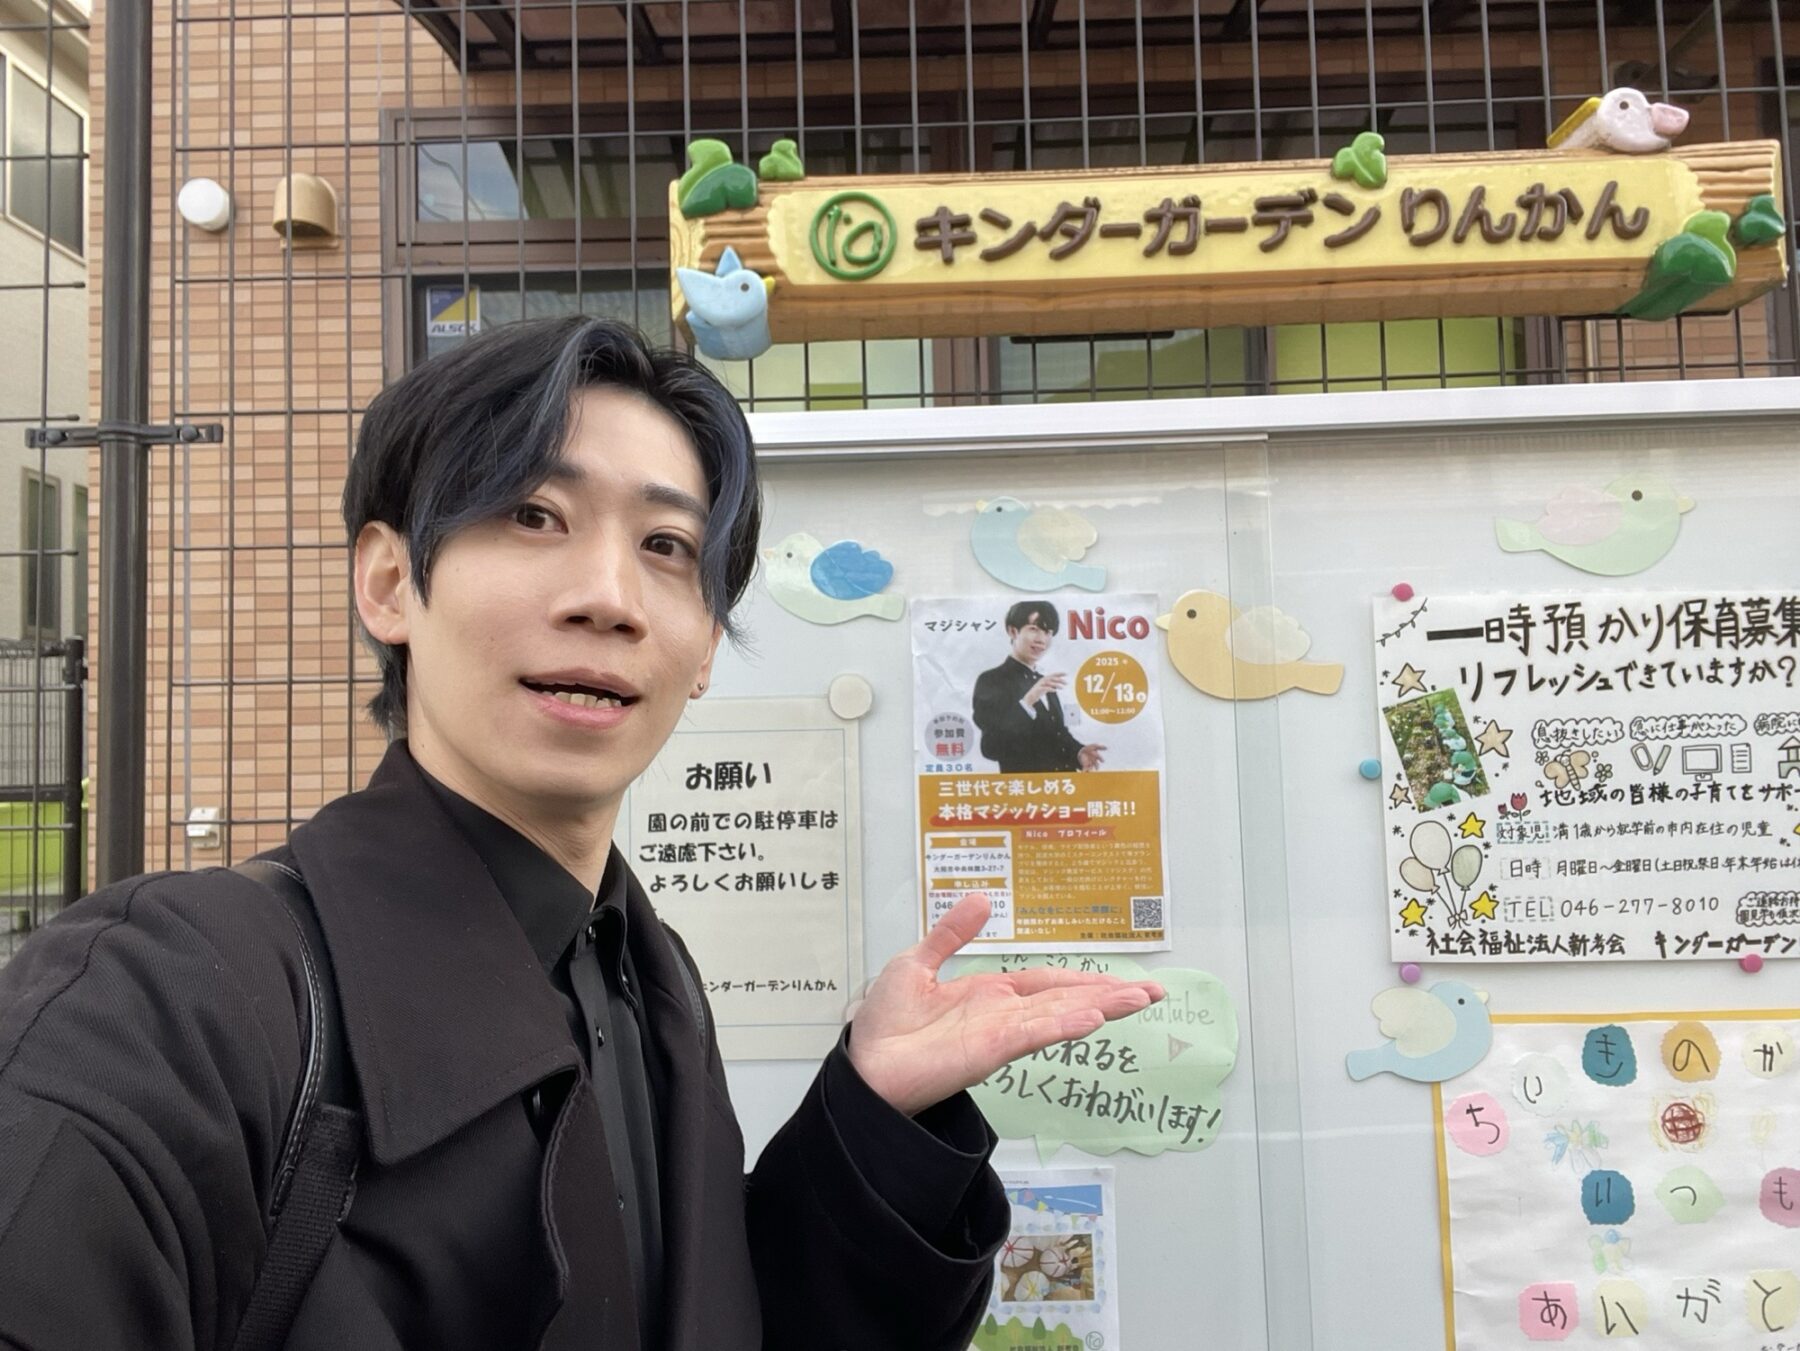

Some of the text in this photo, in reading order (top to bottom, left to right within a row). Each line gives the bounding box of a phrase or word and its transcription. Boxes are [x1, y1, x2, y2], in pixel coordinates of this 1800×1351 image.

[924, 618, 998, 633] マジシャン
[1066, 606, 1150, 641] Nico
[1095, 657, 1119, 667] 2025
[1083, 671, 1135, 703] 12/13
[934, 728, 965, 739] 参加費
[1756, 715, 1800, 732] 病院に
[1536, 726, 1619, 744] 息抜きしたい
[935, 741, 965, 757] 無料
[684, 760, 772, 791] お願い
[937, 778, 1077, 797] 三世代で楽しめる
[647, 810, 839, 833] 園の前での駐停車は
[1057, 828, 1108, 838] プロフィール
[1498, 823, 1546, 841] 対象児
[638, 842, 765, 864] ご遠慮下さい。
[1510, 858, 1543, 879] 日時
[649, 871, 840, 893] よろしくお願いしま
[1507, 896, 1719, 918] TEL 046-277-8010
[983, 1064, 1222, 1144] ろしくおねがいします!
